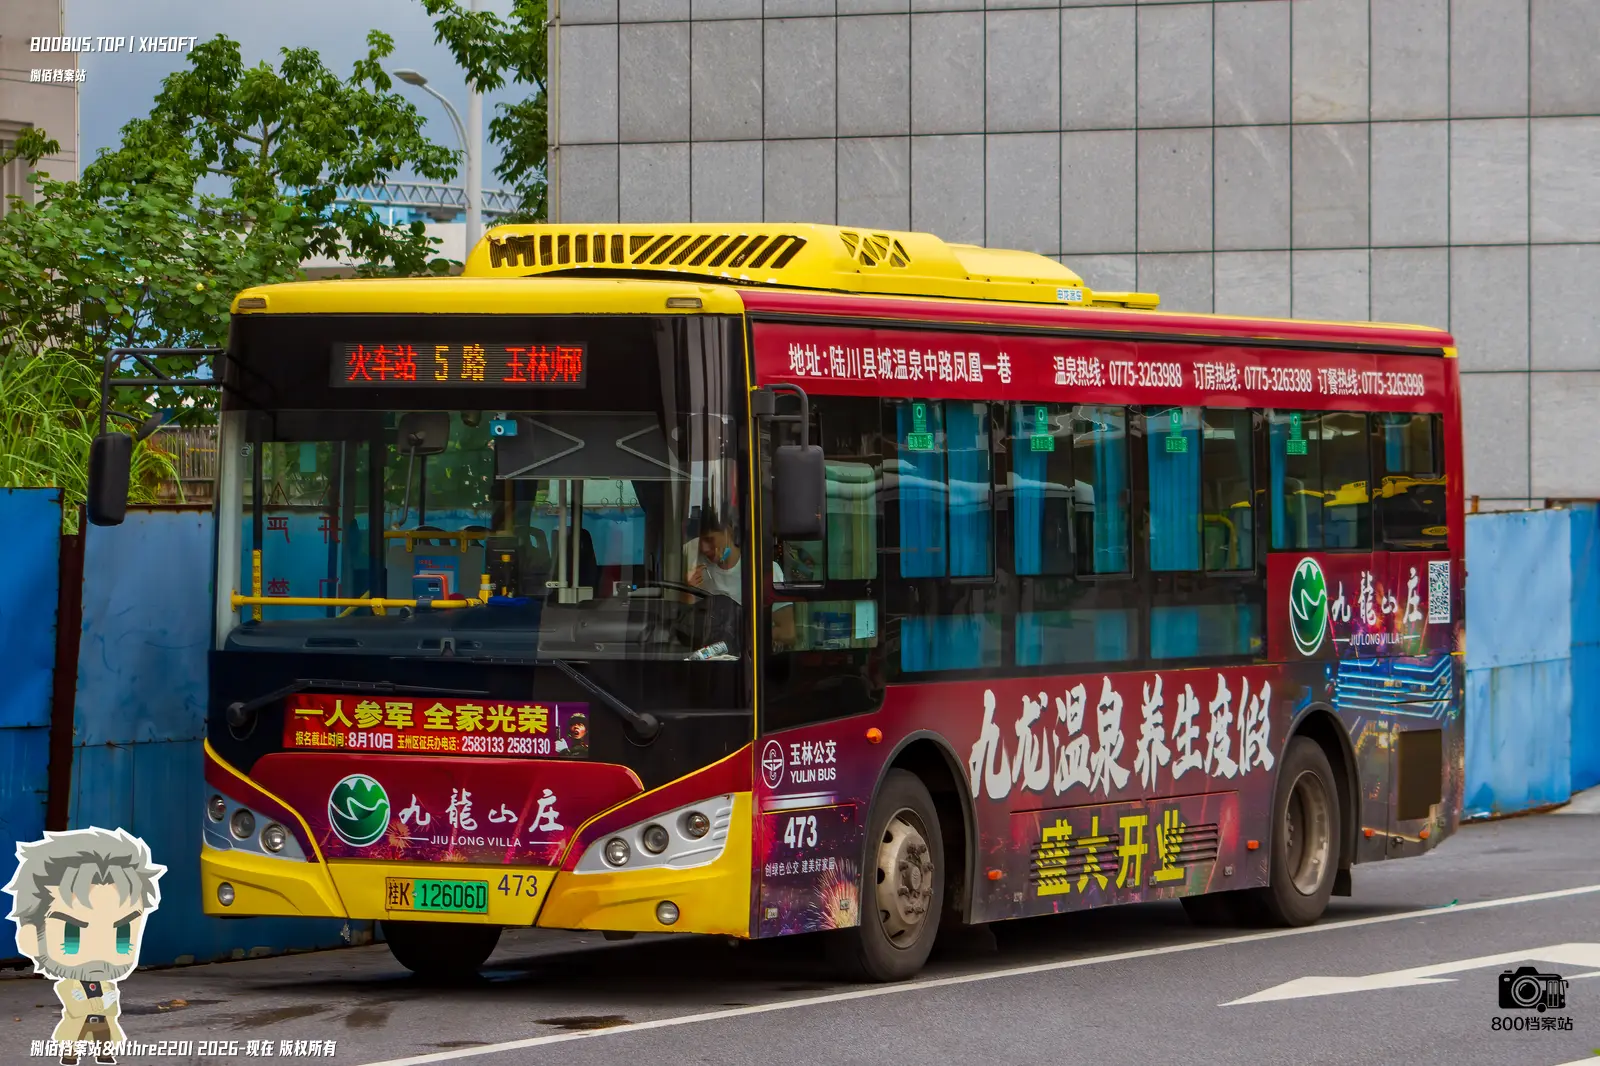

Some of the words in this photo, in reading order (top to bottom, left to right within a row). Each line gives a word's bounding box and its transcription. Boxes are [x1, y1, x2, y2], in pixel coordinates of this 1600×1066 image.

[347, 344, 418, 381] 火车站
[434, 345, 449, 381] 5
[461, 344, 487, 381] 路
[295, 700, 414, 730] 一人参军
[423, 702, 549, 734] 全家光荣
[507, 738, 550, 754] 2583130
[789, 740, 837, 766] 玉林公交
[790, 770, 816, 784] YULIN
[818, 768, 836, 781] BUS
[487, 837, 522, 847] VILLA
[784, 815, 818, 849] 473
[498, 875, 538, 897] 473
